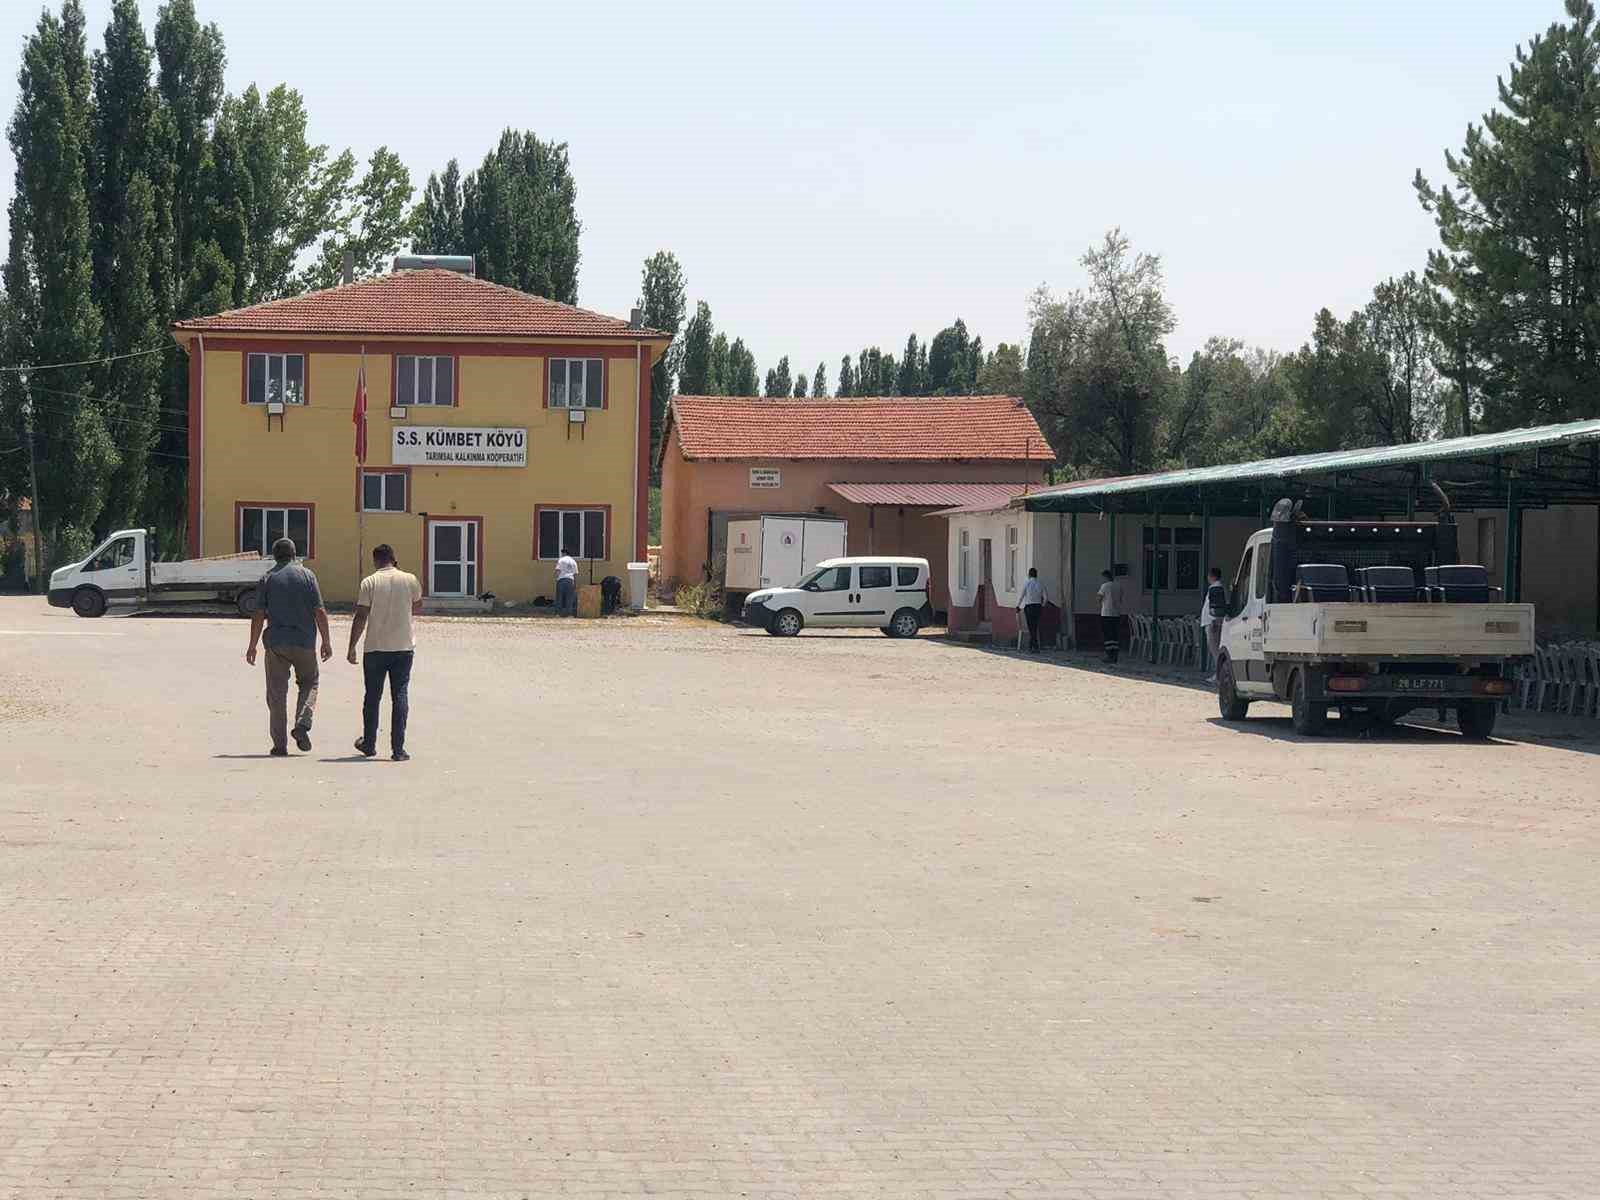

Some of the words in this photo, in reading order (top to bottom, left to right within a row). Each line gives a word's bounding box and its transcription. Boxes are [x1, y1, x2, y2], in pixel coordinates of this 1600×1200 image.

[397, 431, 422, 446] S.S.
[426, 428, 482, 447] KÜMBET
[486, 429, 524, 448] KÖYÜ
[425, 451, 454, 462] TARIMSAL
[455, 452, 485, 462] KALKINMA
